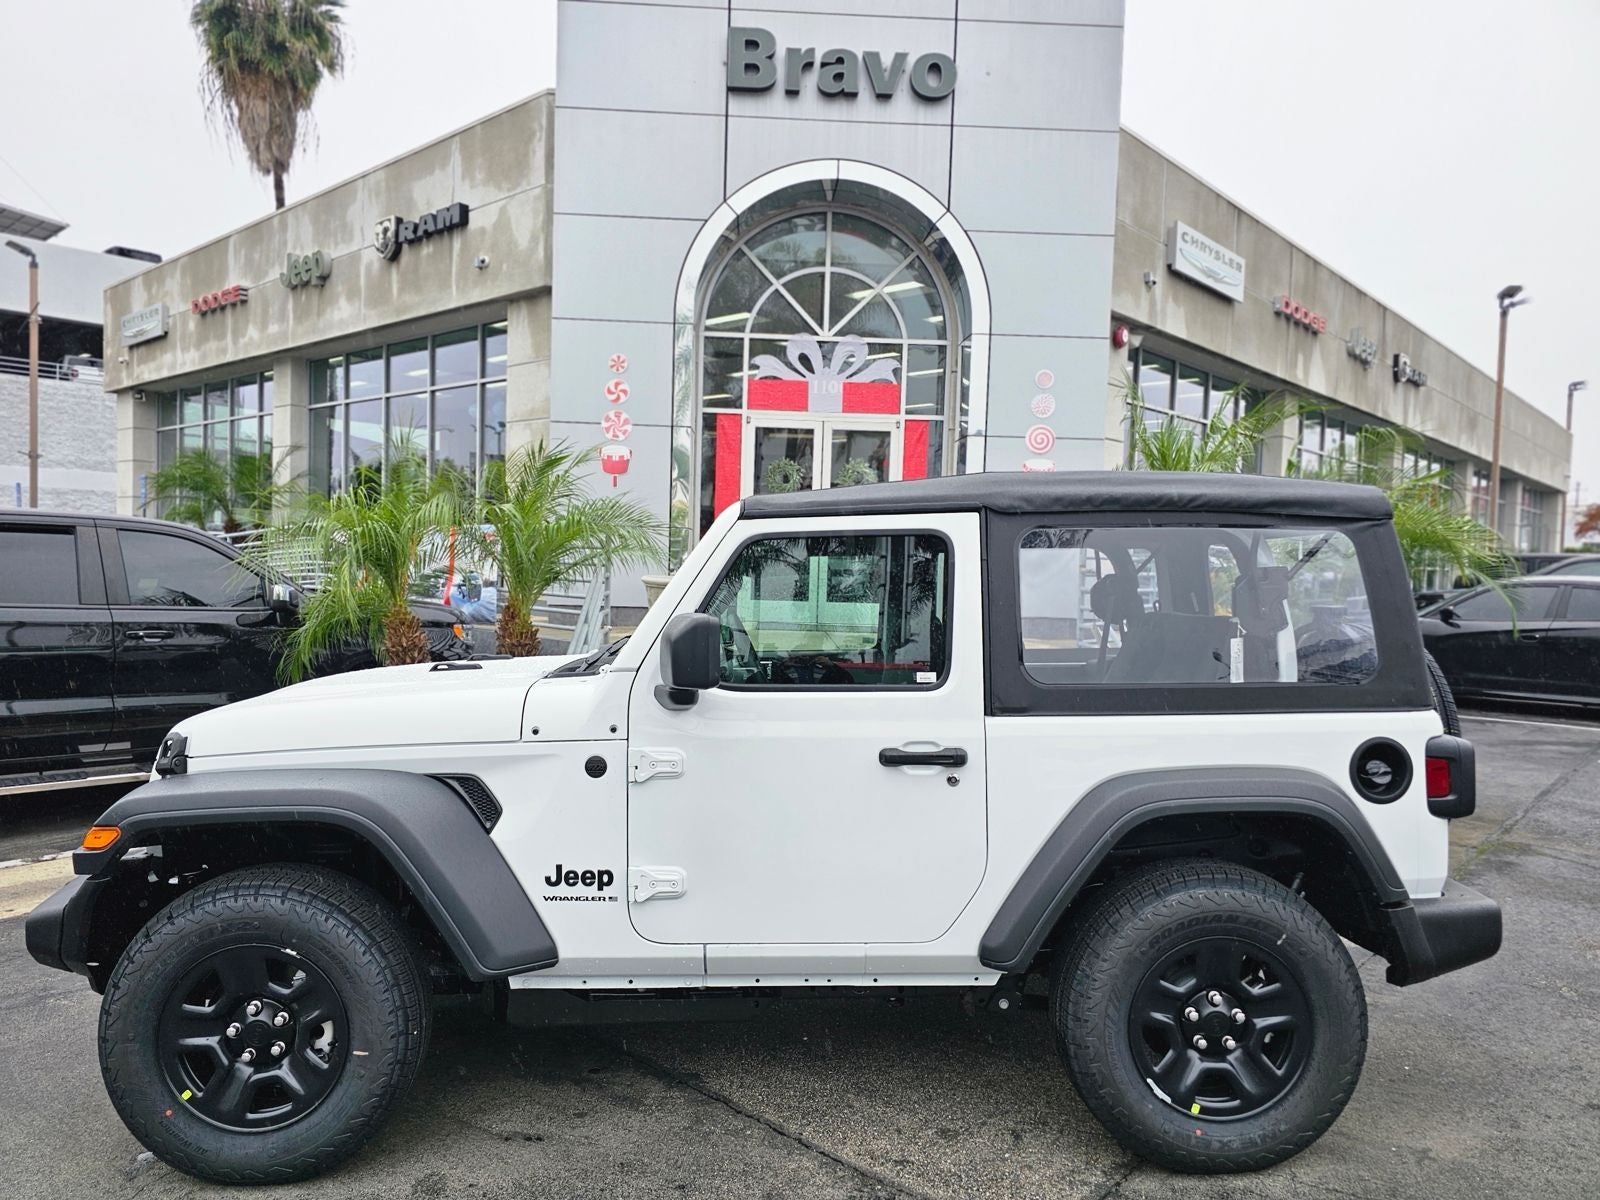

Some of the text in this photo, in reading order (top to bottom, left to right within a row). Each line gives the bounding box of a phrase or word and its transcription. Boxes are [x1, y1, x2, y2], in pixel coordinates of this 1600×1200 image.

[727, 27, 957, 100] Bravo
[399, 203, 466, 243] RAM
[280, 250, 330, 289] Jeep
[1181, 231, 1243, 273] CHRYSLER
[191, 284, 243, 315] DODGE
[1280, 295, 1327, 333] DODGE
[544, 864, 614, 891] Jeep
